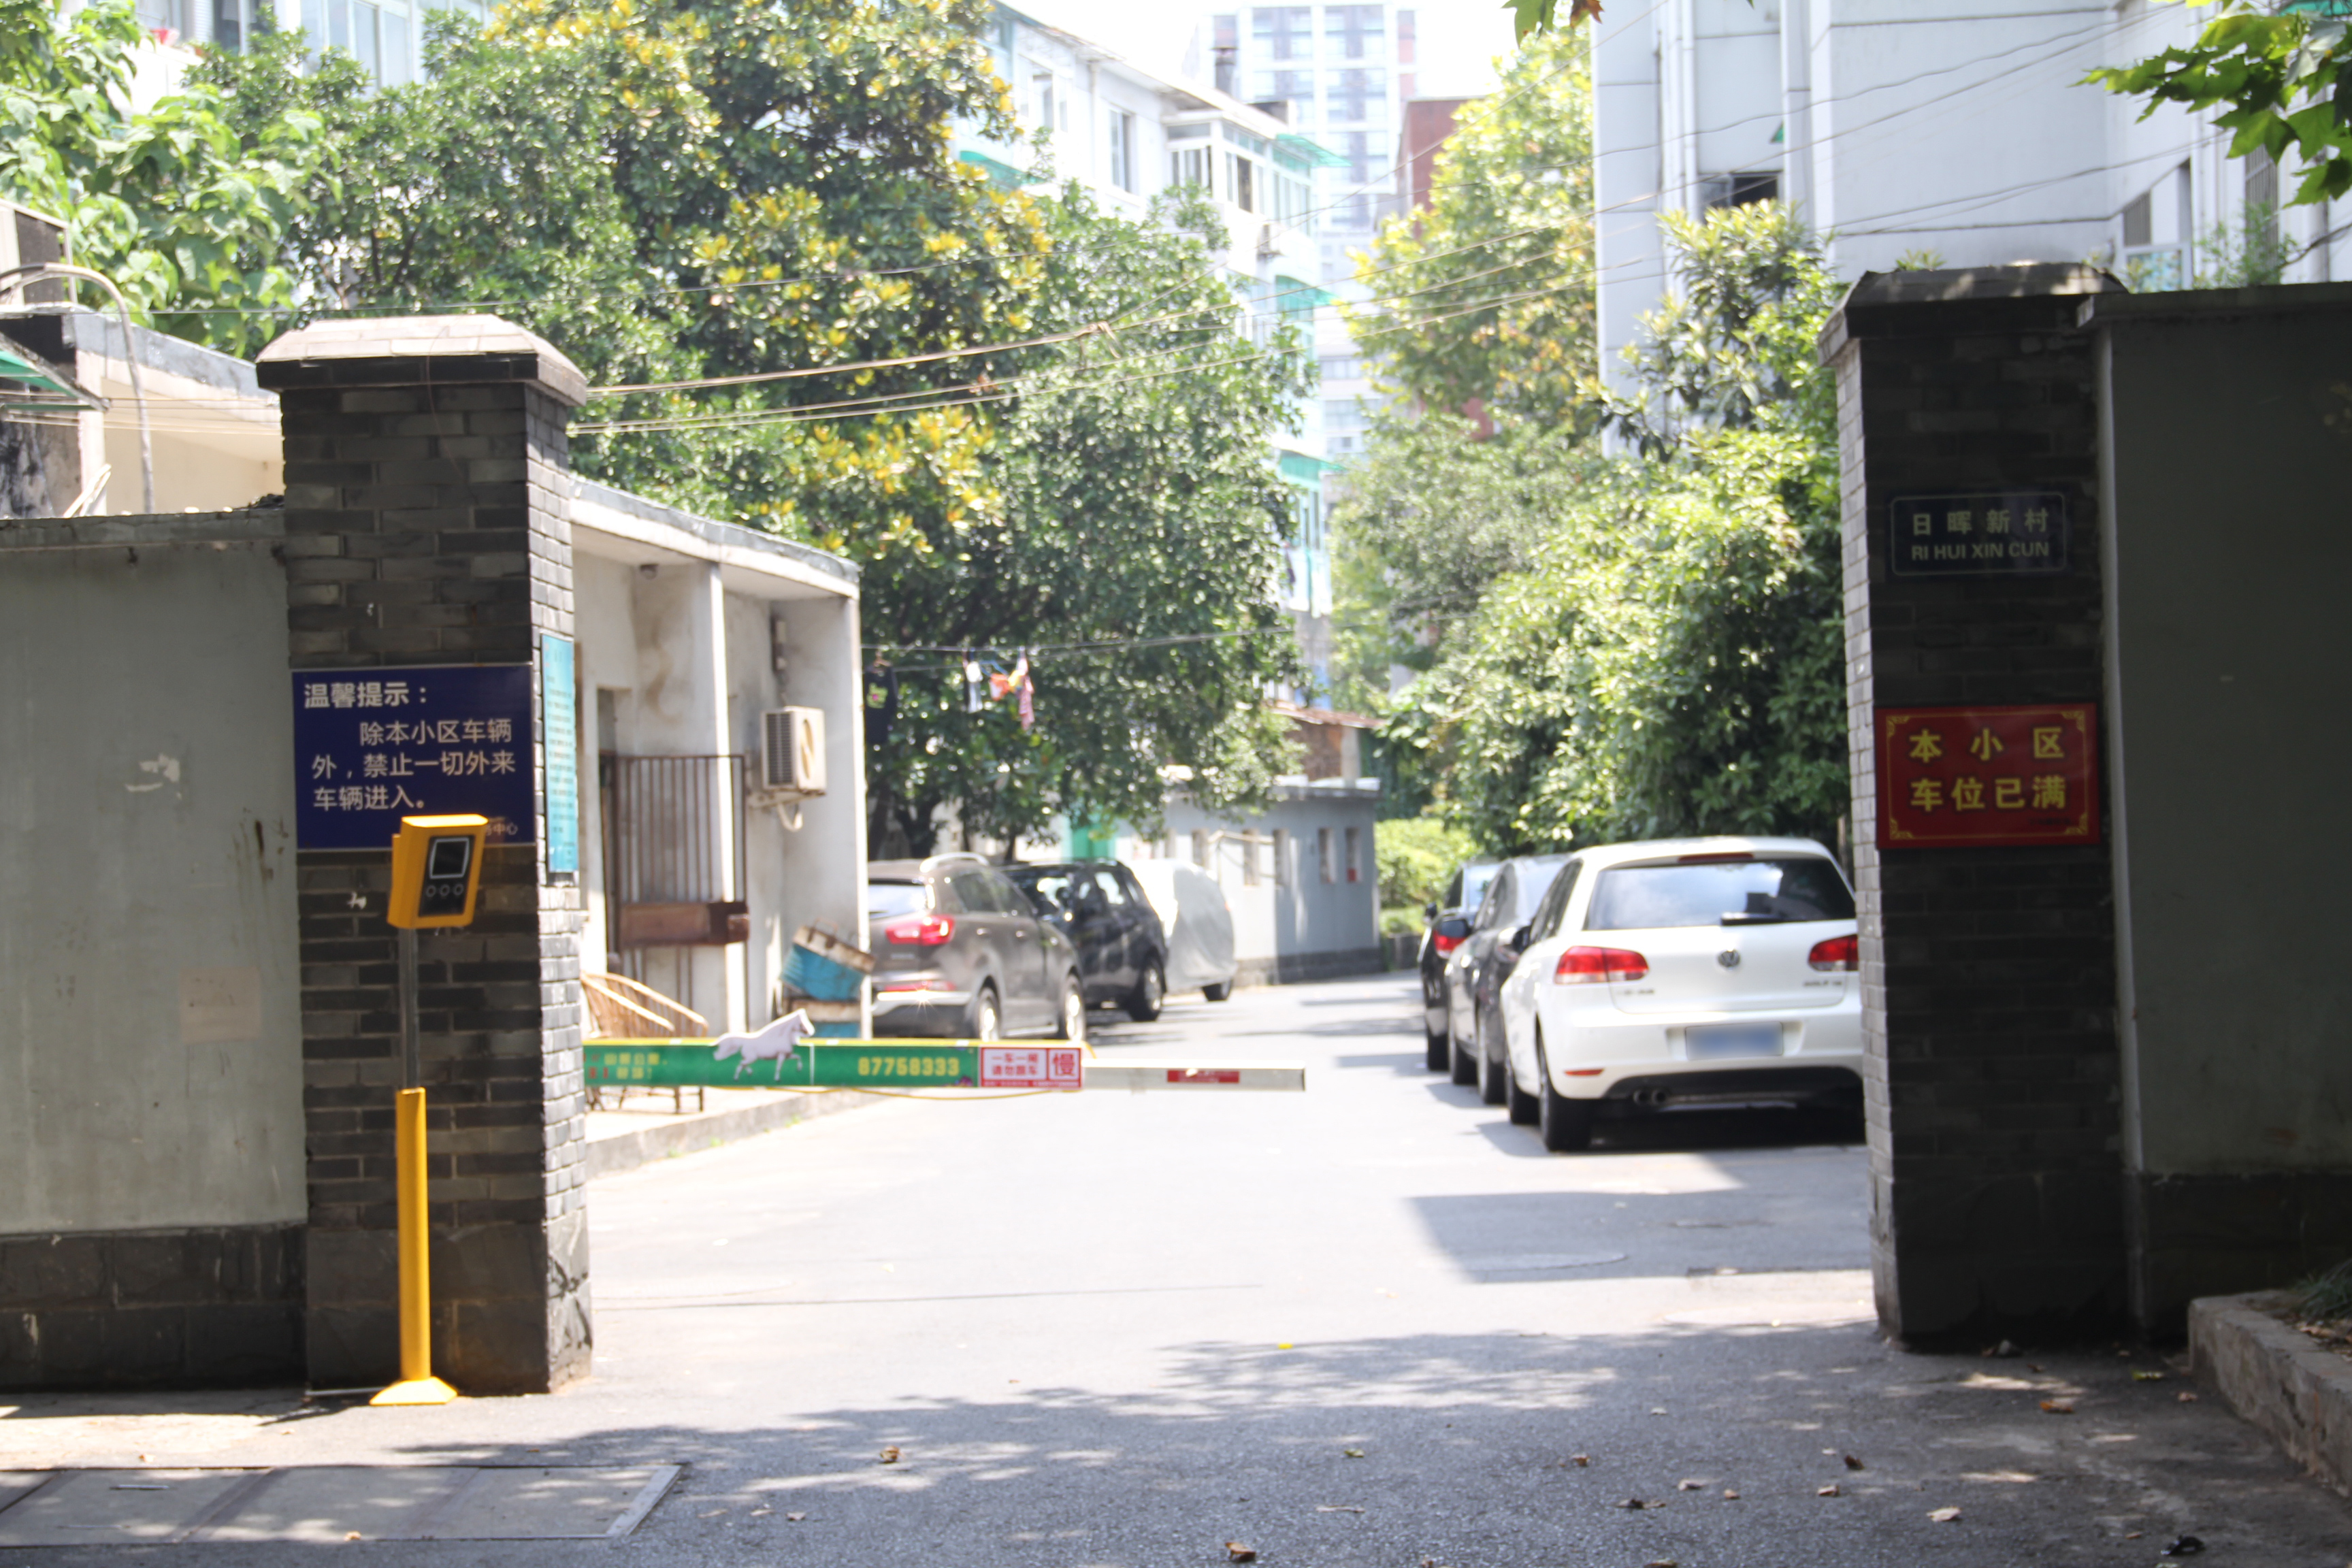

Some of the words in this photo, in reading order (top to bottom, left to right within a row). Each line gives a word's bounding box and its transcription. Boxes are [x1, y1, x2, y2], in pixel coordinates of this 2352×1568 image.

[1913, 508, 2049, 536] 日晖新村
[1912, 546, 1929, 561] RI
[1934, 545, 1967, 560] HUI
[1972, 543, 2004, 559] XIN
[2008, 541, 2049, 557] CUN
[359, 719, 512, 746] 除本小区车辆
[1910, 726, 2064, 763] 本小区
[1911, 776, 2066, 813] 车位已满
[1053, 1052, 1075, 1077] 慢
